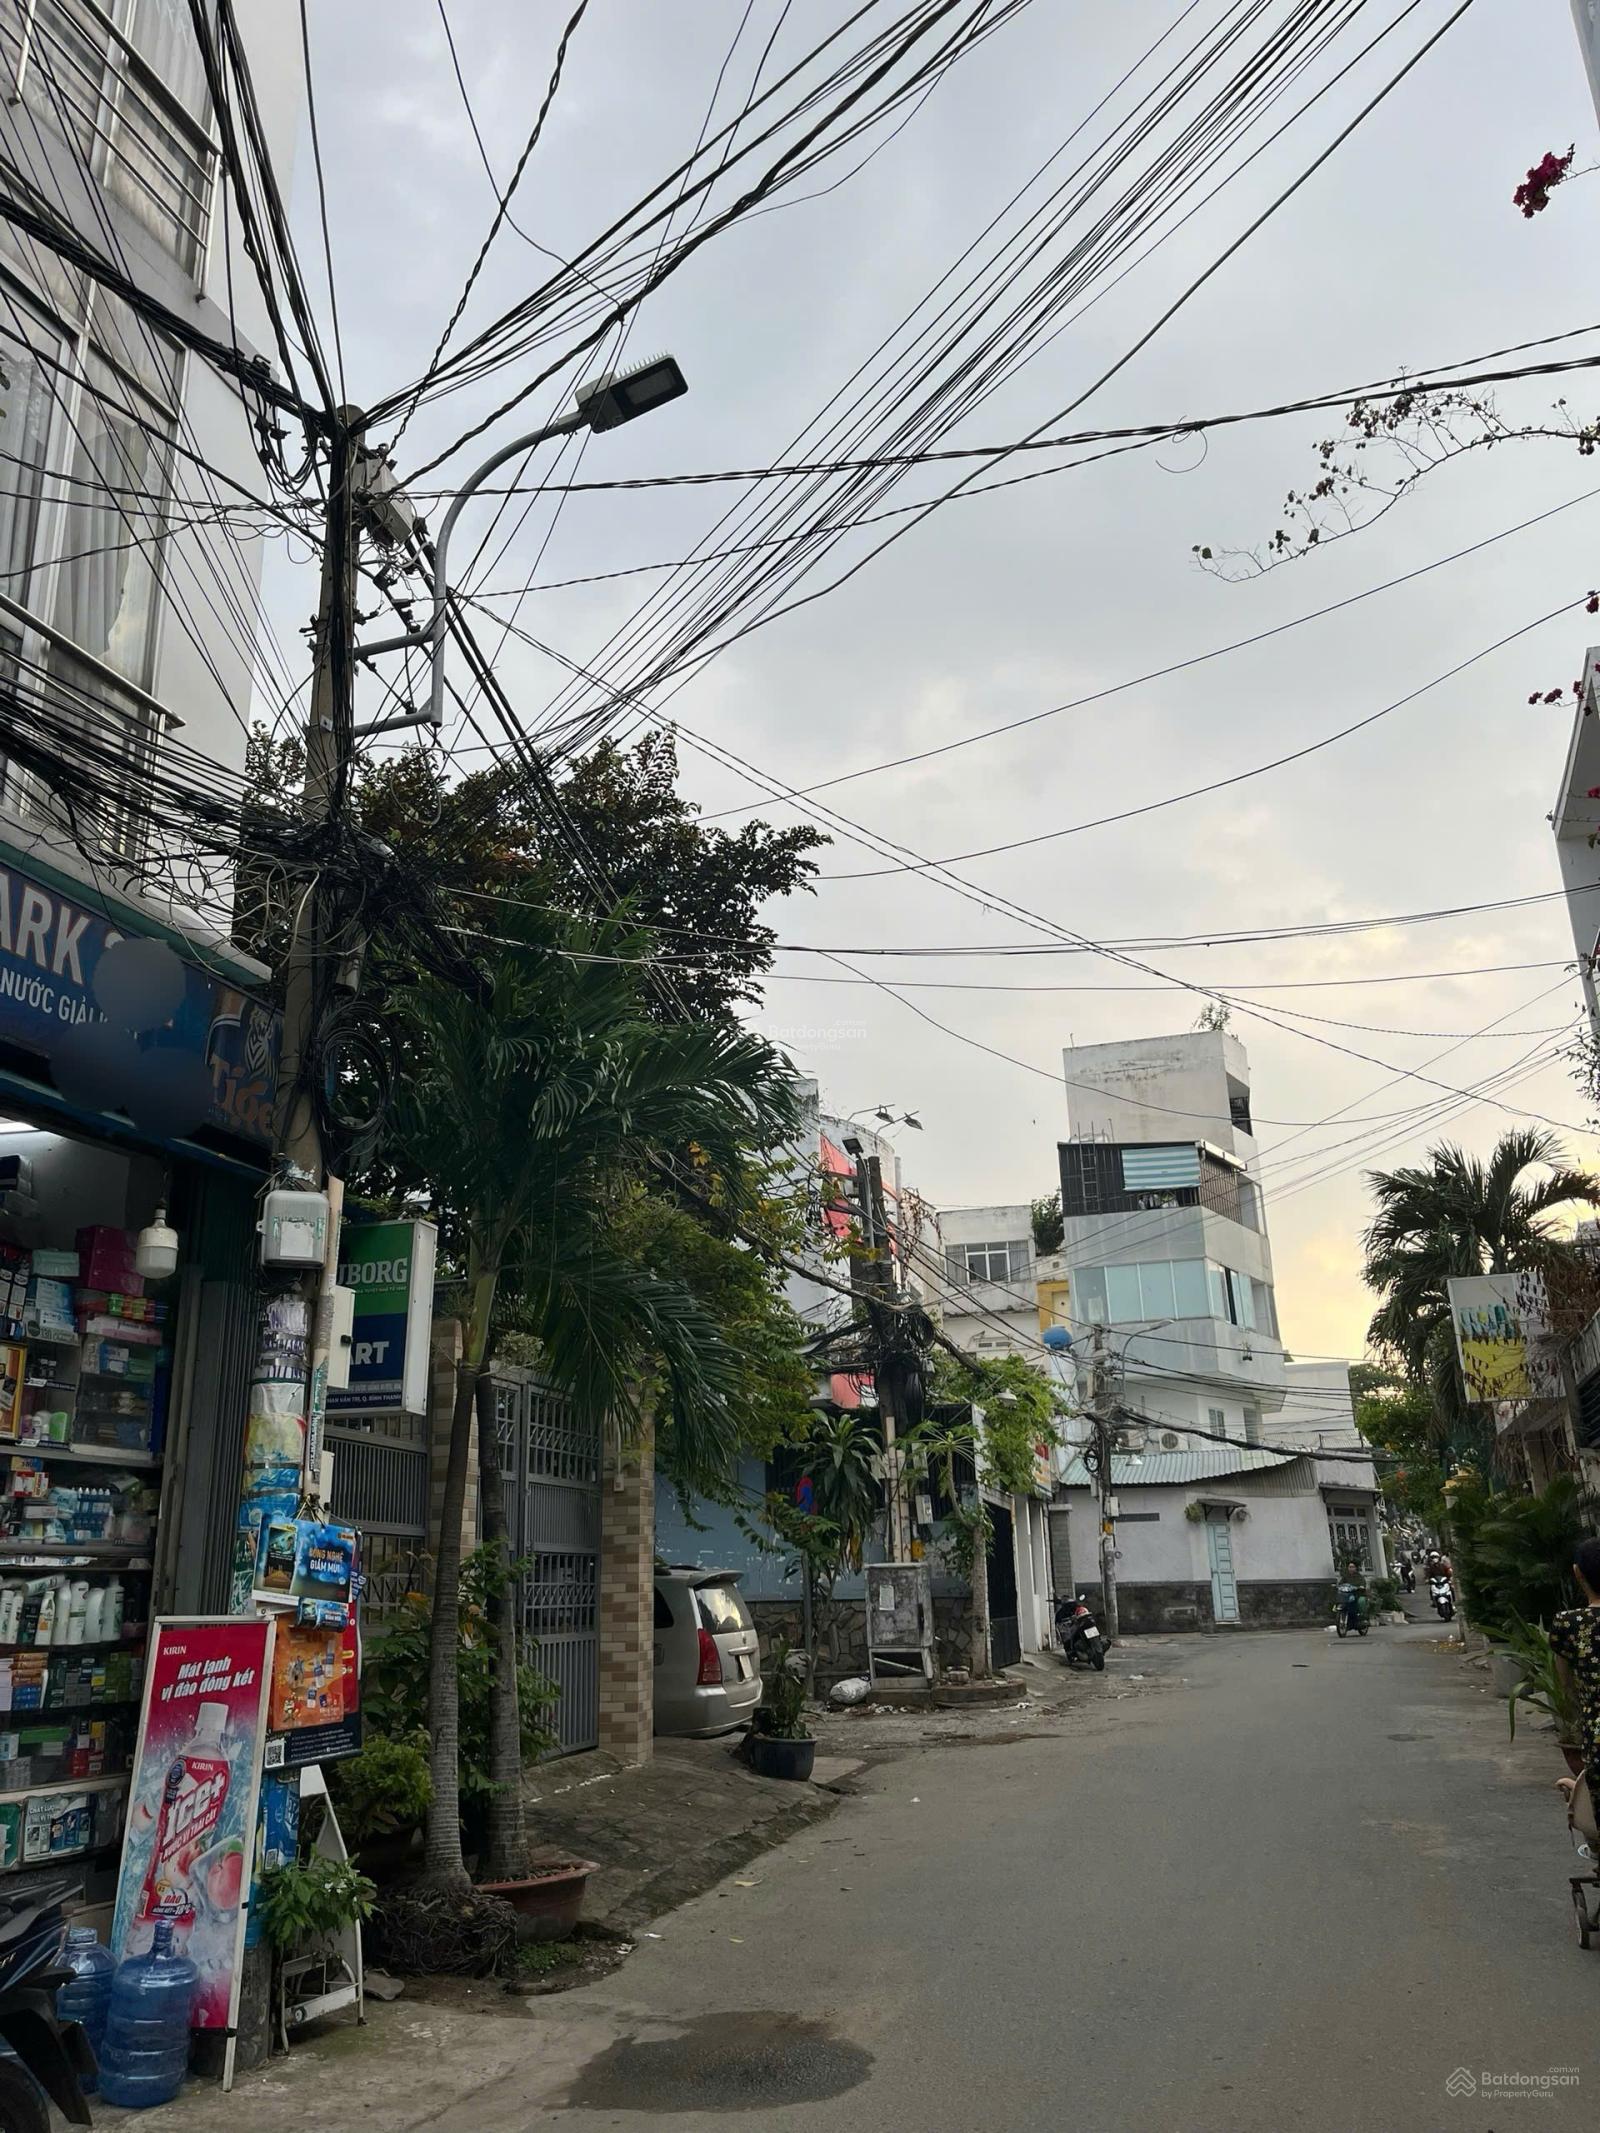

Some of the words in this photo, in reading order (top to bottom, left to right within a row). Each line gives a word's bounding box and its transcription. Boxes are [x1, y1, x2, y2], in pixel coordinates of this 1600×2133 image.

[0, 967, 55, 1015] NƯỚC
[163, 1645, 187, 1656] KIRIN
[177, 1661, 203, 1680] Mát
[202, 1655, 232, 1677] lạnh
[161, 1684, 174, 1703] vị
[174, 1681, 198, 1698] đào
[232, 1666, 255, 1688] kết
[191, 1761, 214, 1771] KIRIN
